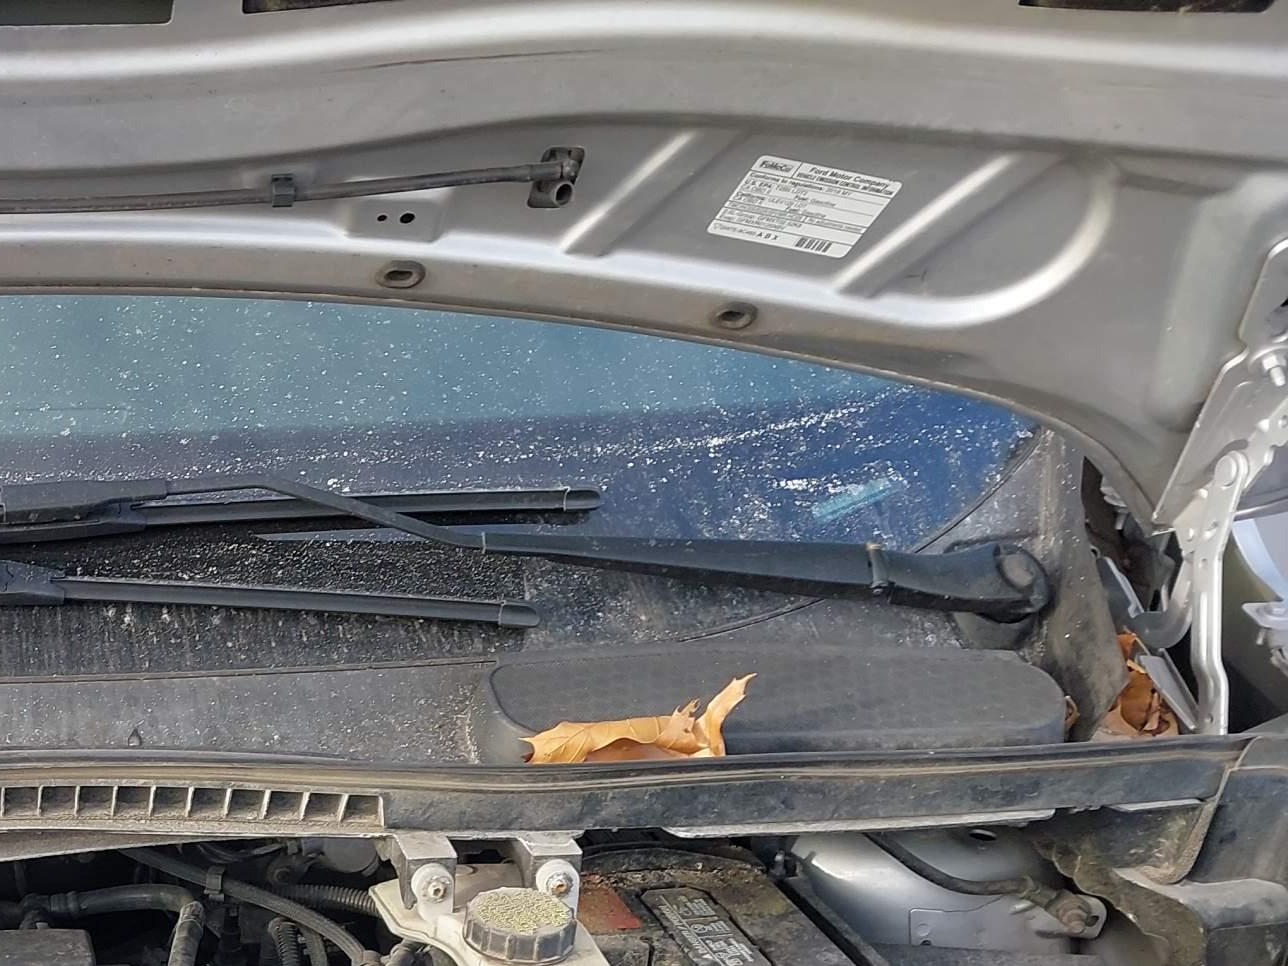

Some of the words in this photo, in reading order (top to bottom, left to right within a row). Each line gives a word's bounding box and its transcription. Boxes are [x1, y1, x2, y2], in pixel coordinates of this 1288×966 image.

[816, 176, 839, 184] EMISSION
[839, 180, 860, 189] CONTROL
[861, 184, 893, 195] INFORMATION
[830, 171, 853, 180] Motor
[854, 176, 889, 188] Company
